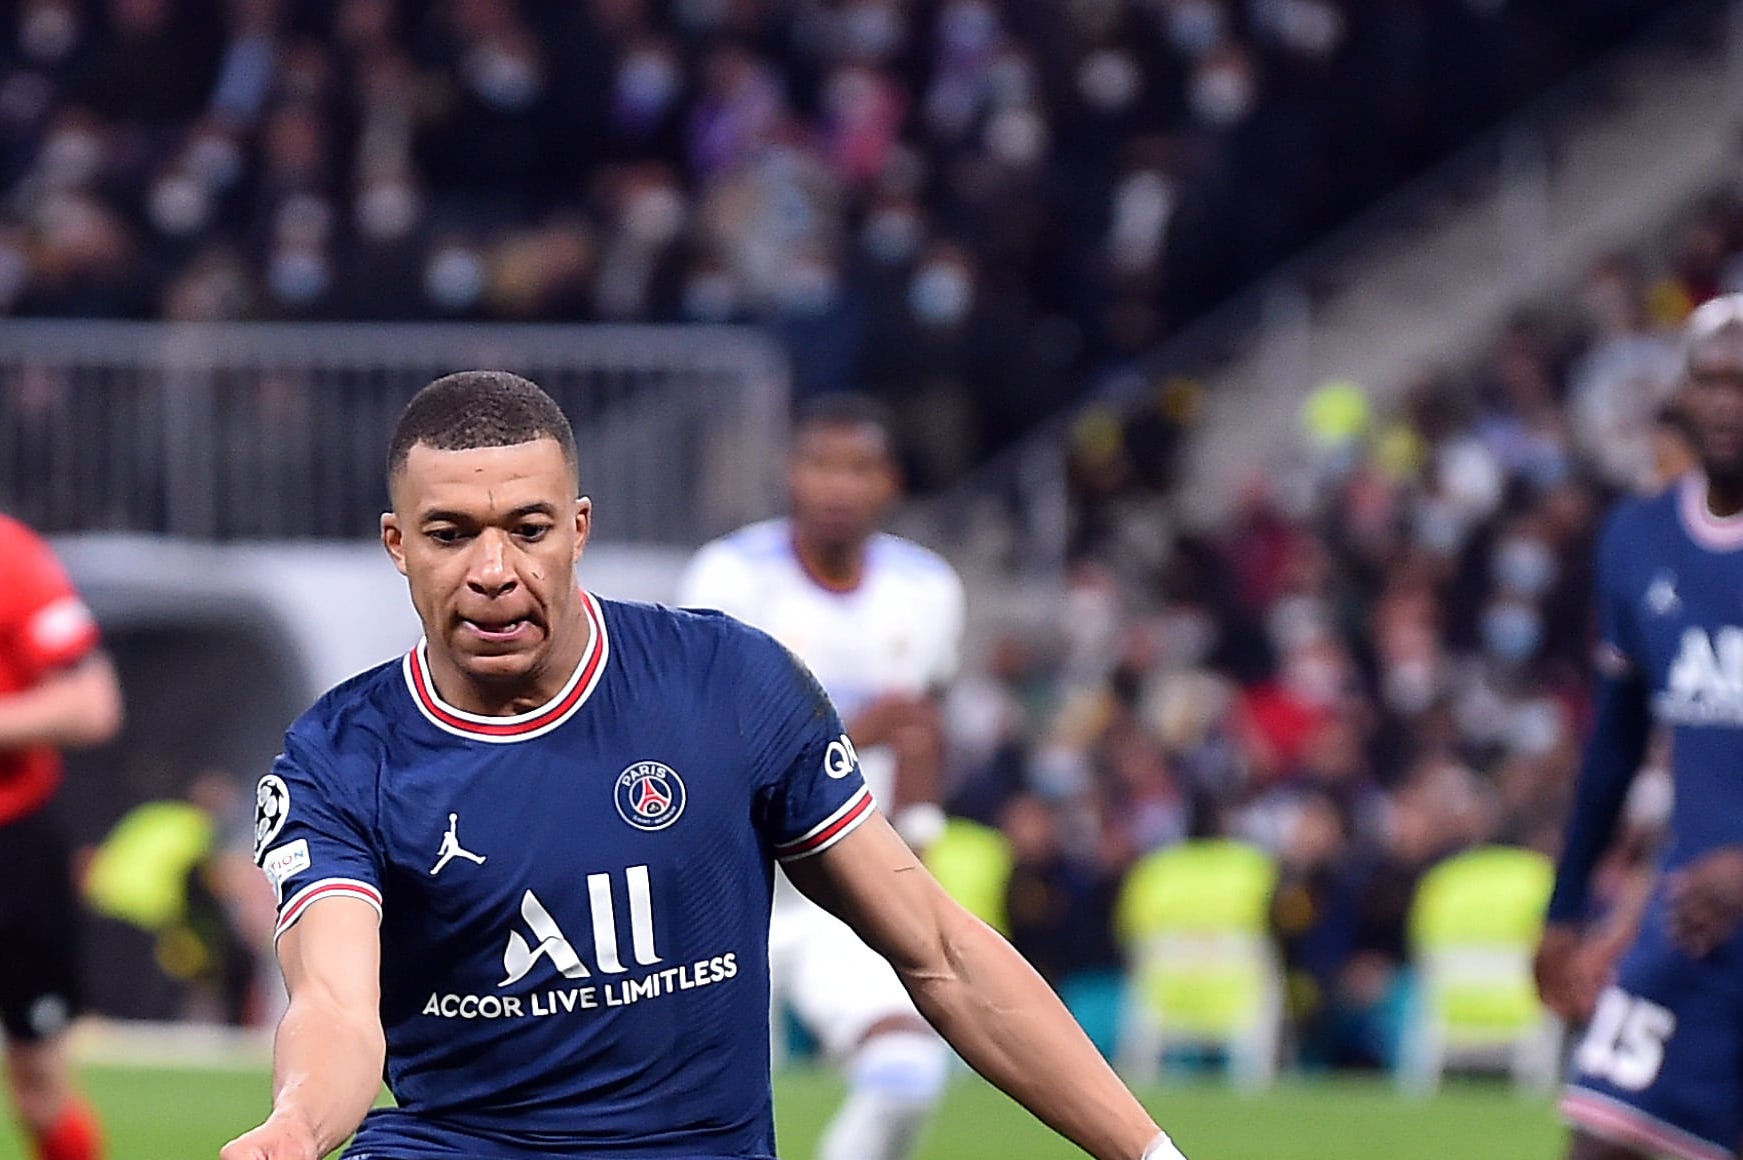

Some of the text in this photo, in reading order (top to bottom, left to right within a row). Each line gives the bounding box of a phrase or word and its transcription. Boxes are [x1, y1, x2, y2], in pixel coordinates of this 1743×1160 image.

[621, 765, 667, 786] PARIS
[422, 952, 738, 1019] ACCOR LIVE LIMITLESS
[1575, 985, 1678, 1093] 15
